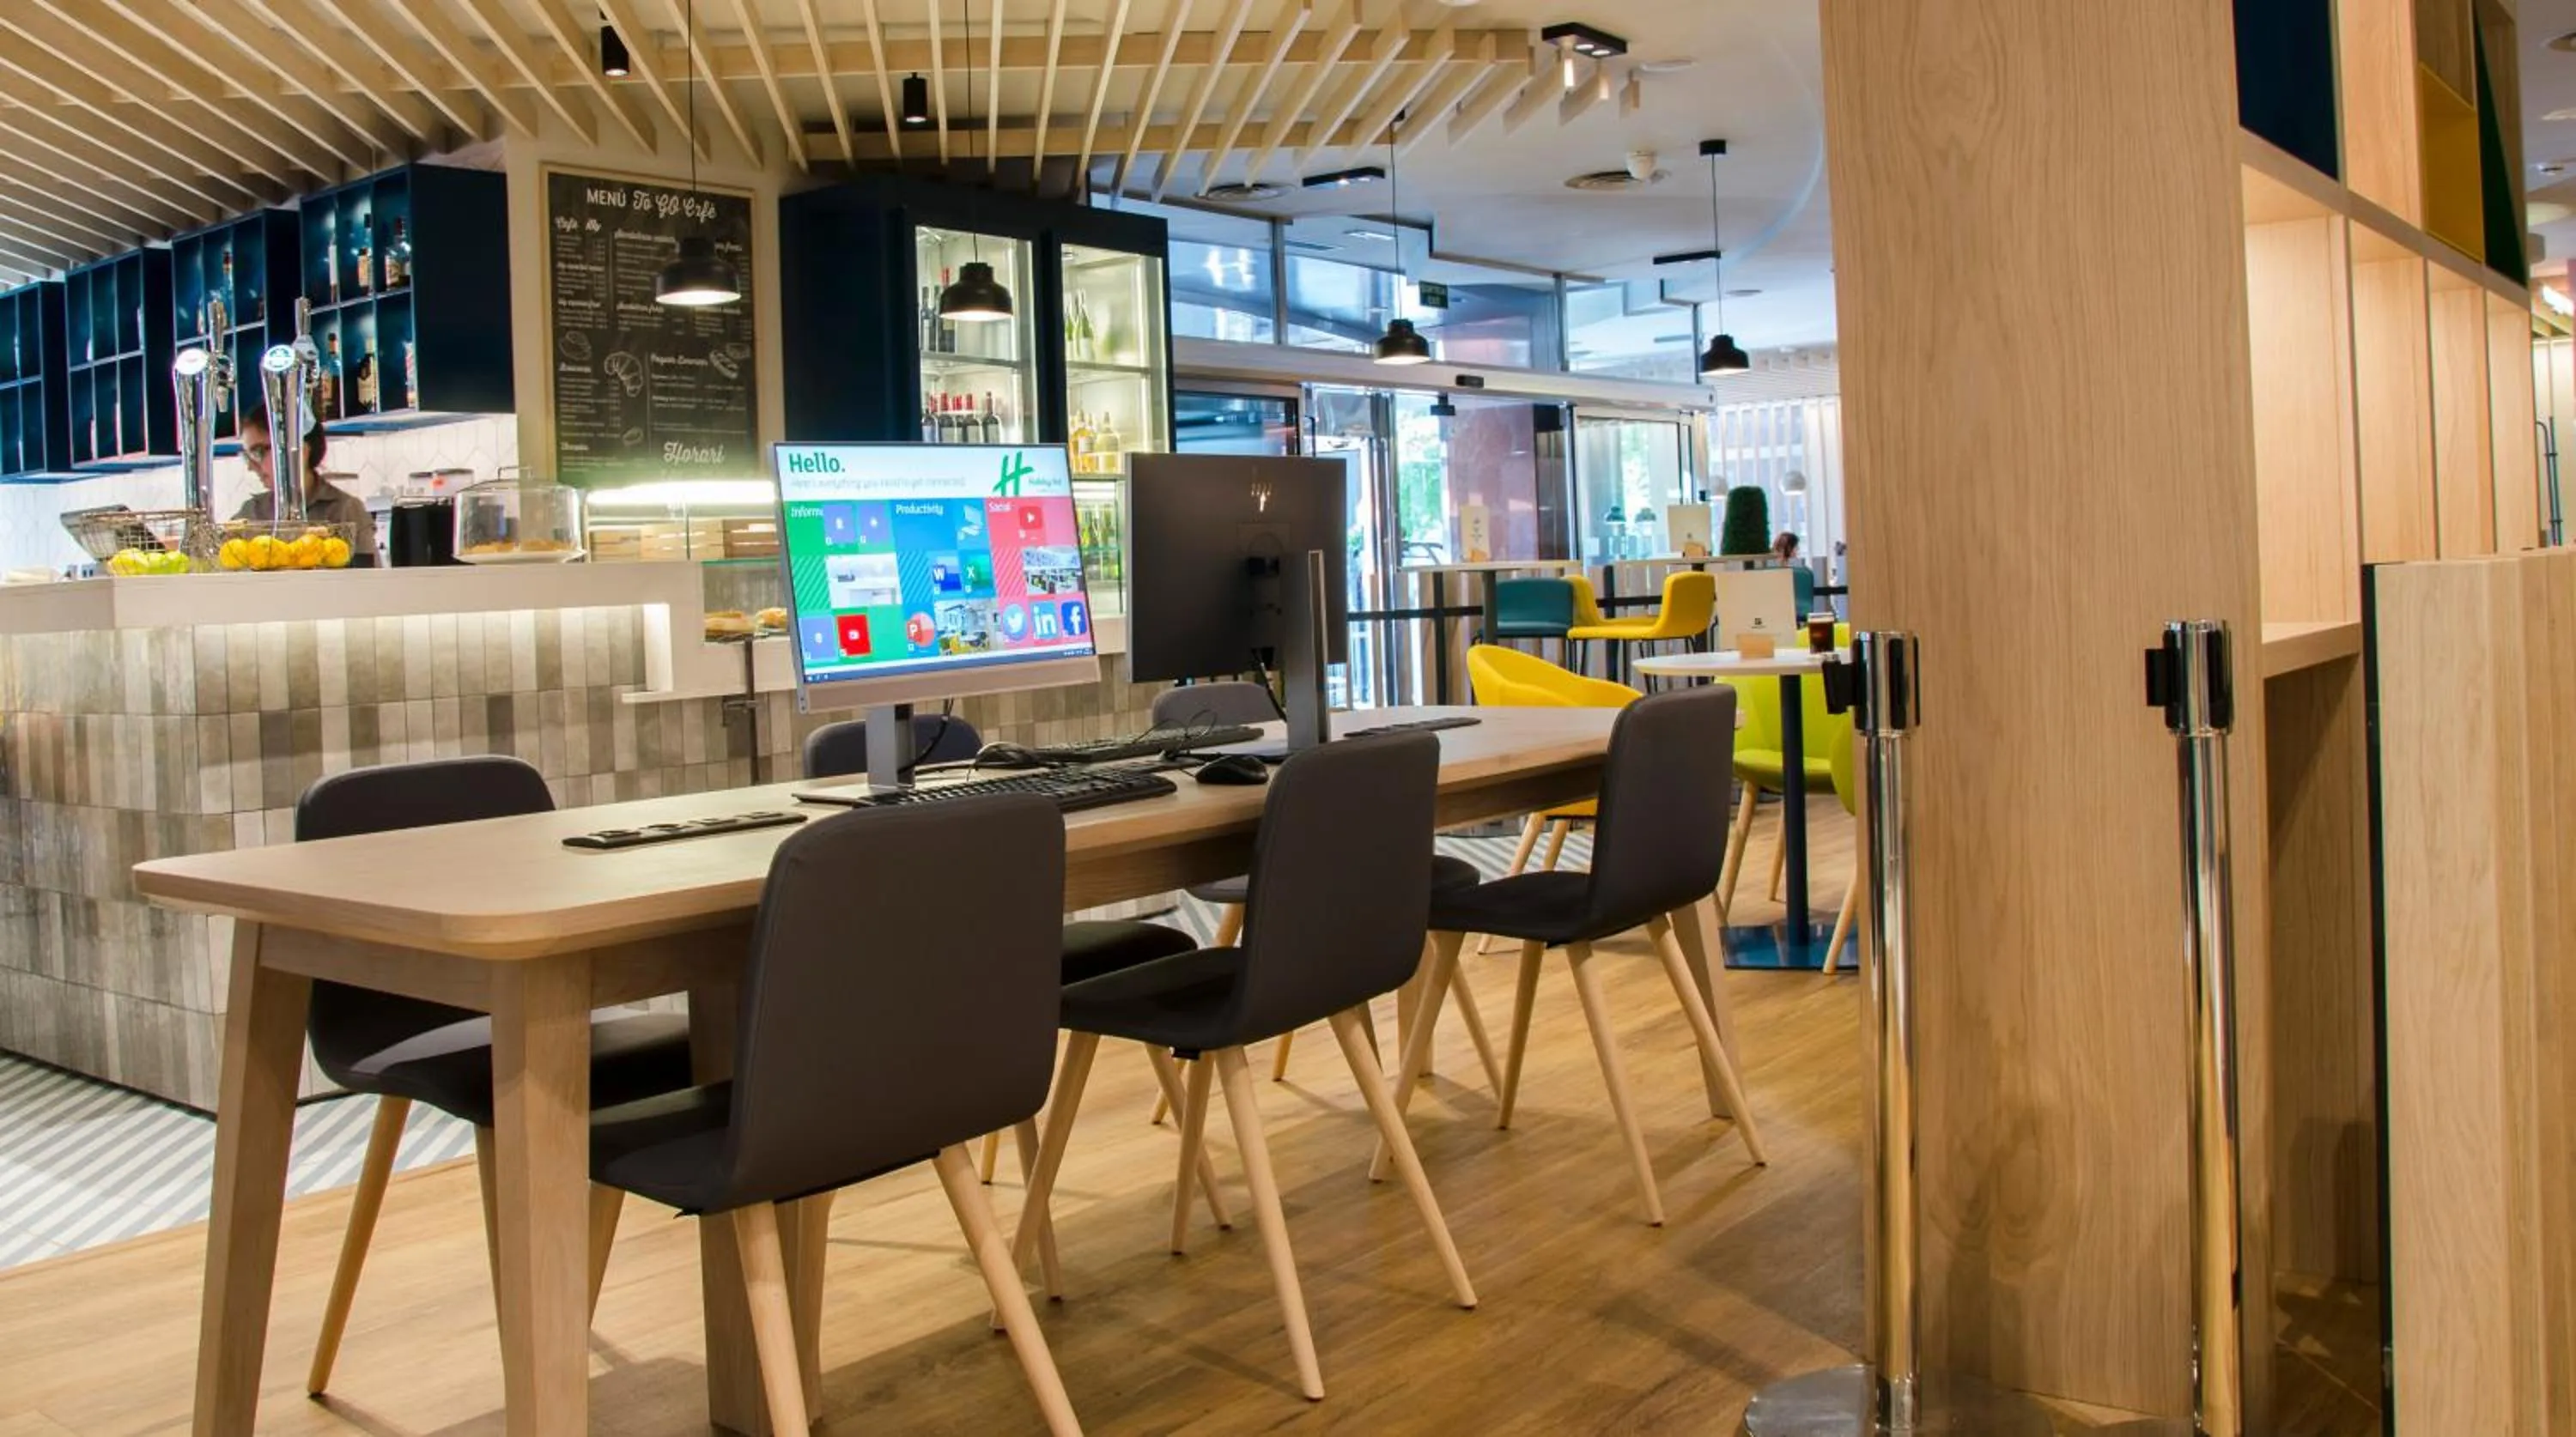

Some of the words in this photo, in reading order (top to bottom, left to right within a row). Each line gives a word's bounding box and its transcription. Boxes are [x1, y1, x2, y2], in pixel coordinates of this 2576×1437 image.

[586, 188, 626, 207] MENÚ
[663, 440, 726, 466] Horari
[788, 452, 846, 473] Hello.
[896, 502, 945, 516] Productivity
[1033, 605, 1057, 640] in
